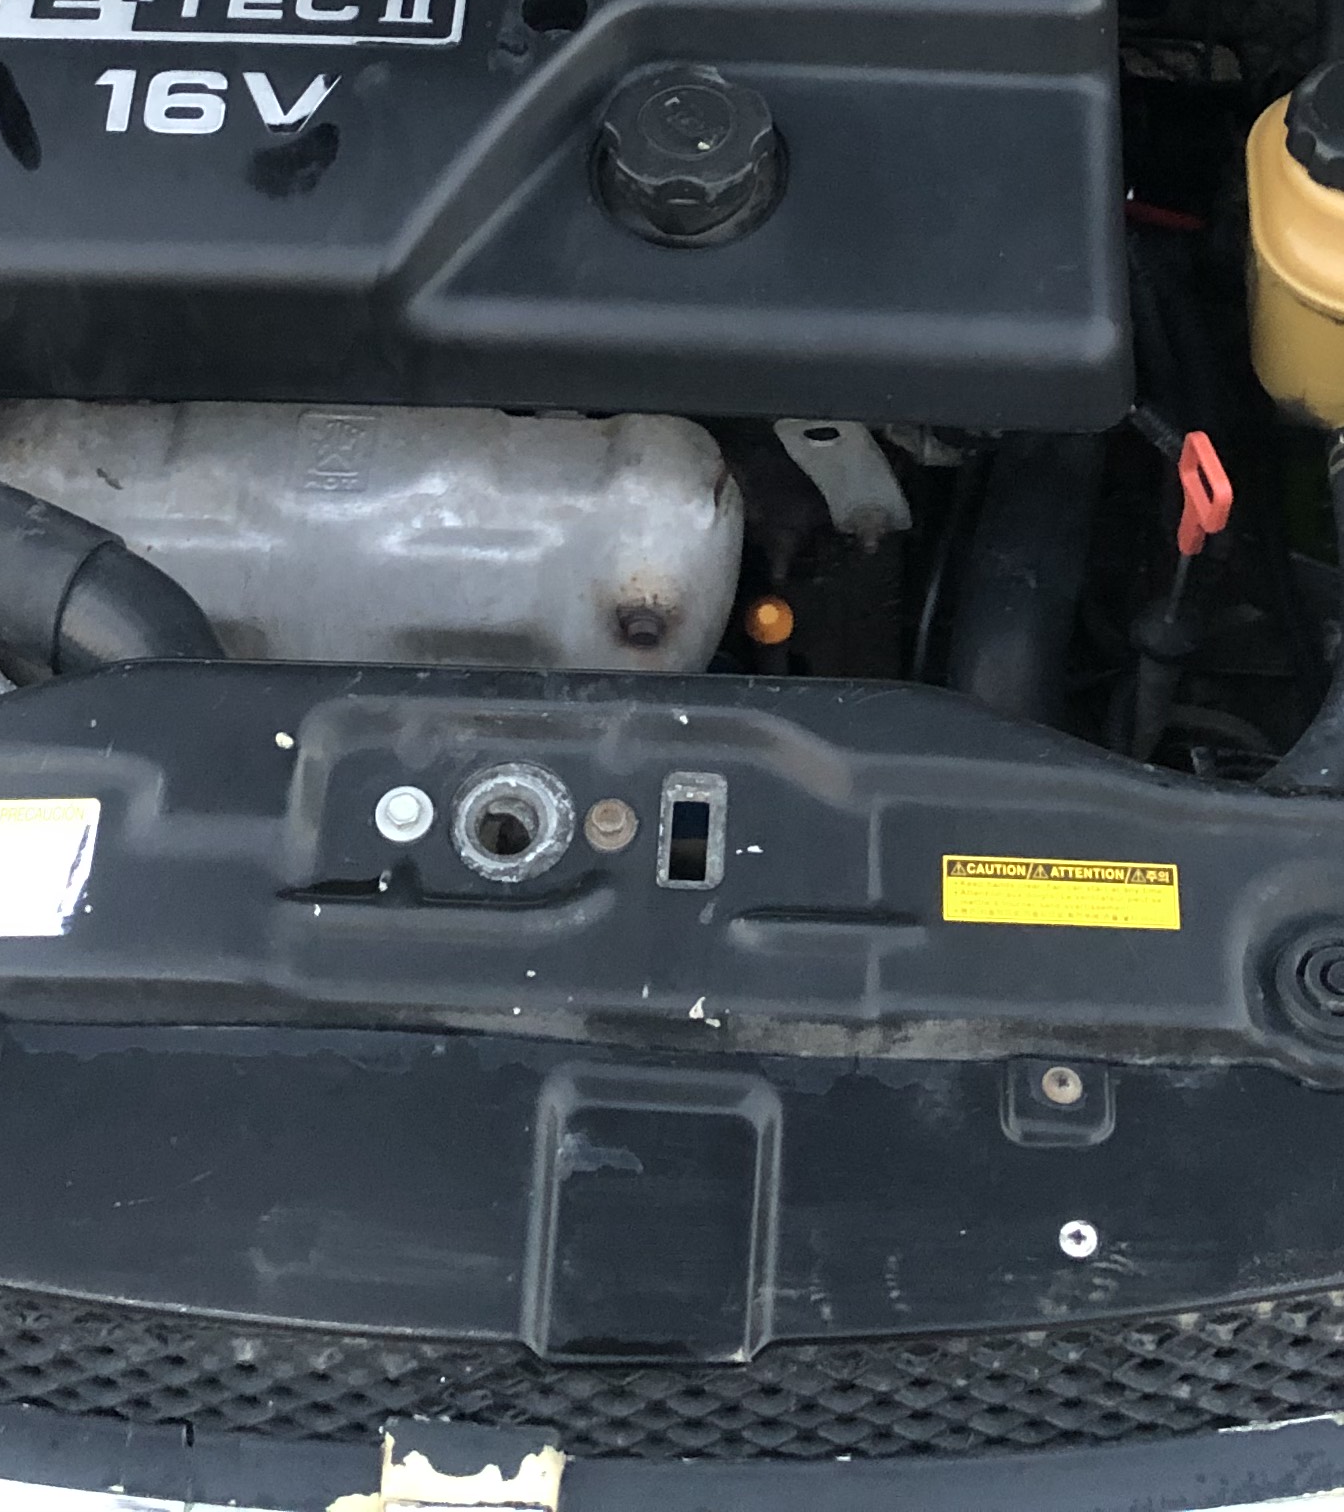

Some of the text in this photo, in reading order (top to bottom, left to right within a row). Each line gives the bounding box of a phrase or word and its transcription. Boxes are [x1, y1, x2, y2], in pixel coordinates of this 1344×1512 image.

[95, 68, 343, 134] 16V
[966, 862, 1125, 881] CAUTION ATTENTION
[1145, 870, 1171, 883] 주의
